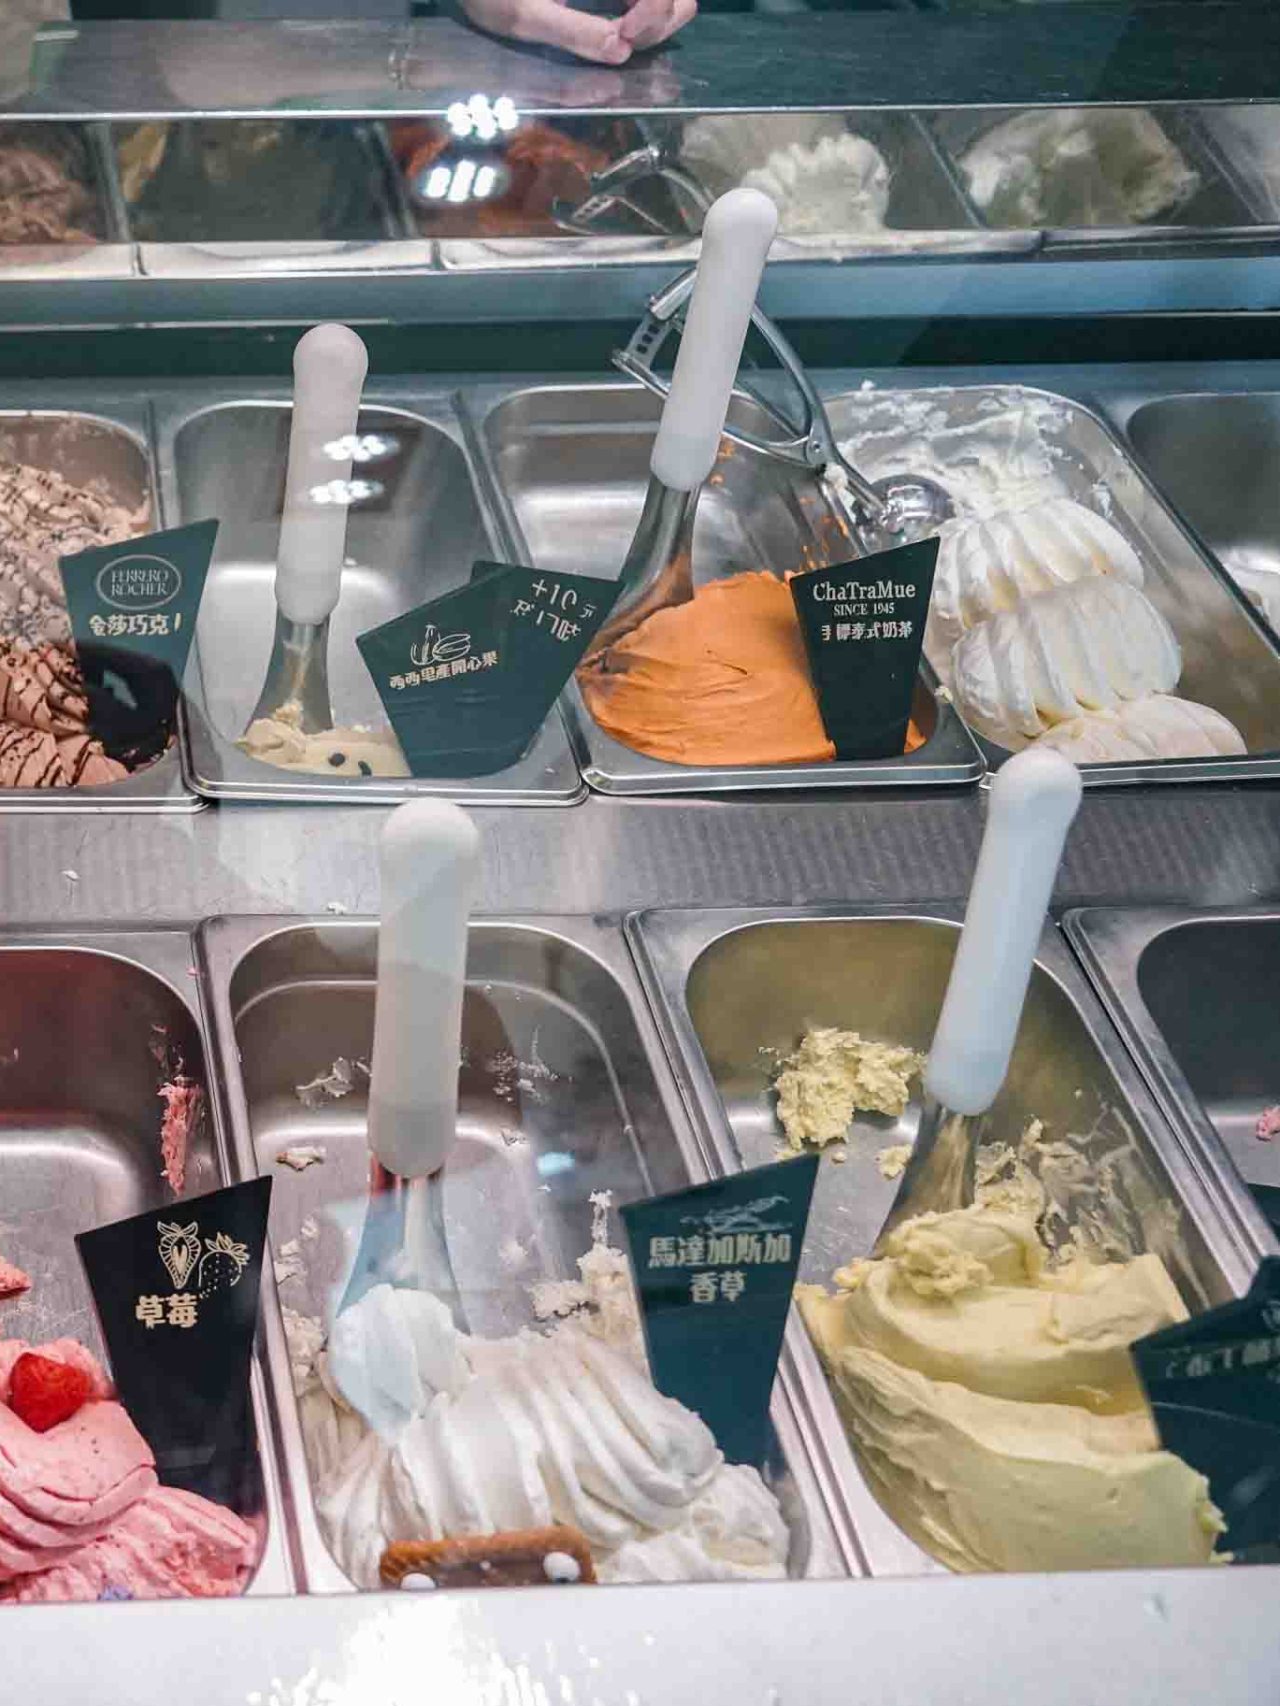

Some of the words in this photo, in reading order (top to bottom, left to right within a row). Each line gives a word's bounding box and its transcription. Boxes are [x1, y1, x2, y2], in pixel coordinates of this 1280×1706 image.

[813, 580, 917, 601] ChaTraMue
[833, 603, 868, 616] SINCE
[873, 602, 895, 614] 1945
[89, 613, 181, 637] 金莎巧克
[648, 1233, 792, 1268] 馬達加斯加
[689, 1271, 747, 1303] 香草
[135, 1293, 198, 1330] 草莓
